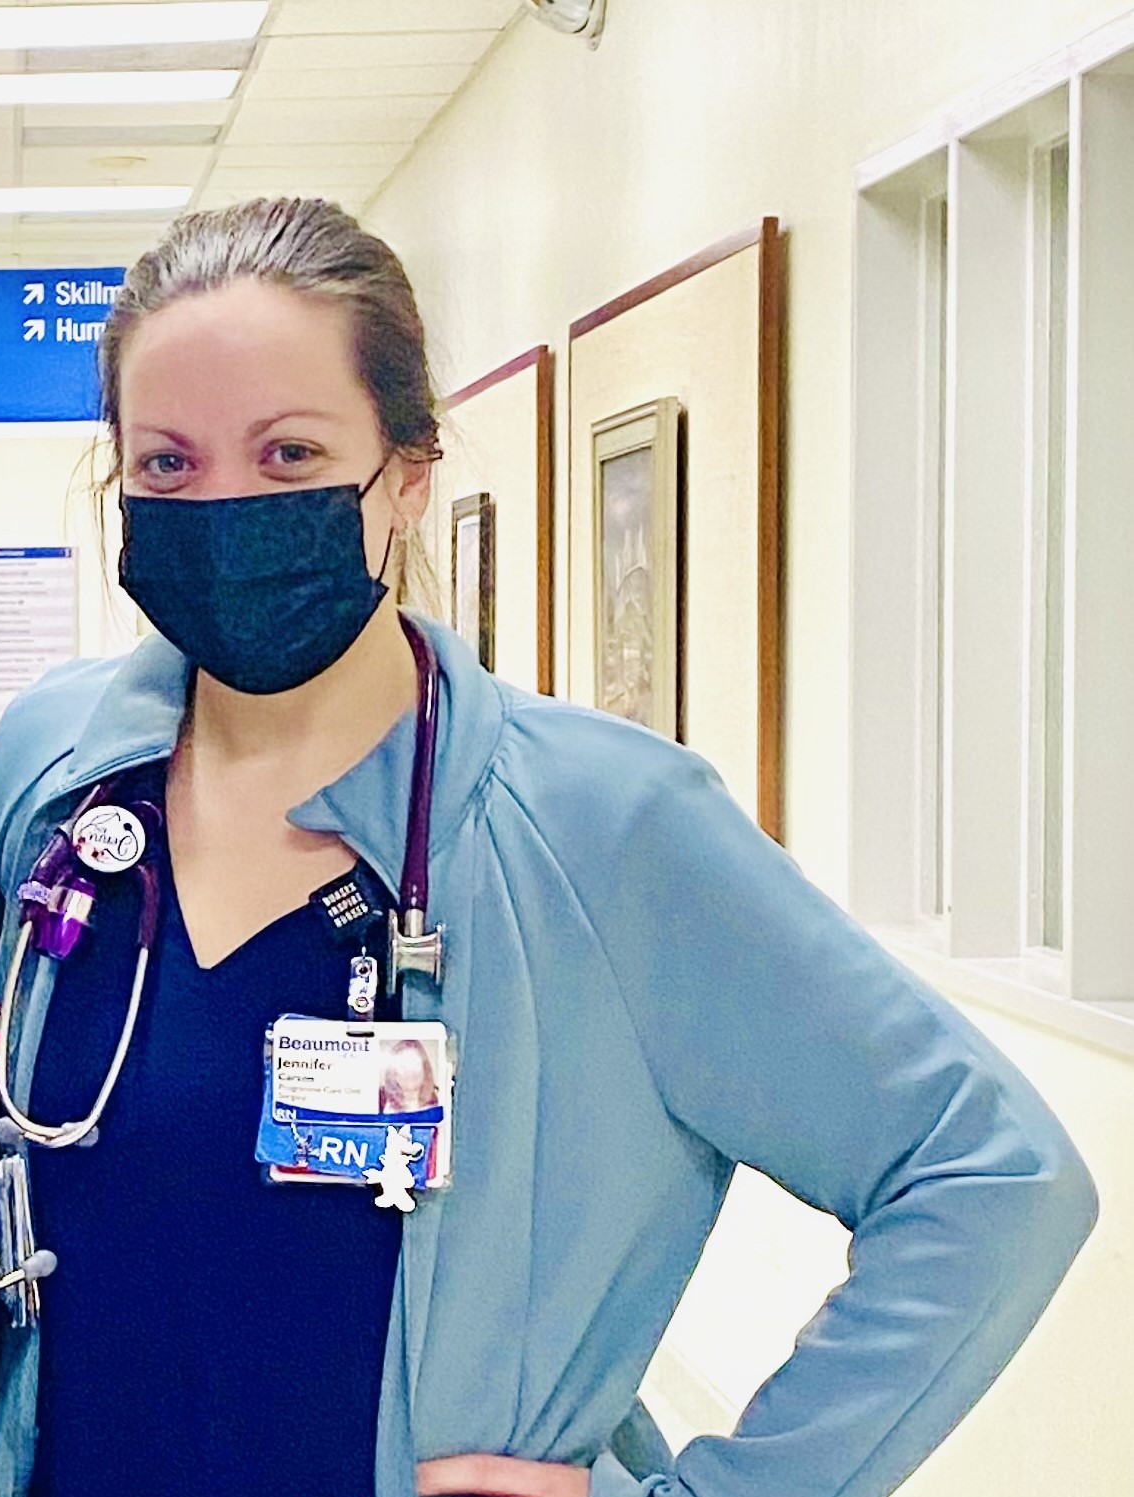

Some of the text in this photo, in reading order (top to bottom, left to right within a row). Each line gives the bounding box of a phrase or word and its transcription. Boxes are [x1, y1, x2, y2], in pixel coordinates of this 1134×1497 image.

[279, 1036, 370, 1052] Beaumont
[277, 1057, 333, 1070] Jennifer
[276, 1108, 297, 1119] RN
[319, 1136, 368, 1168] RN
